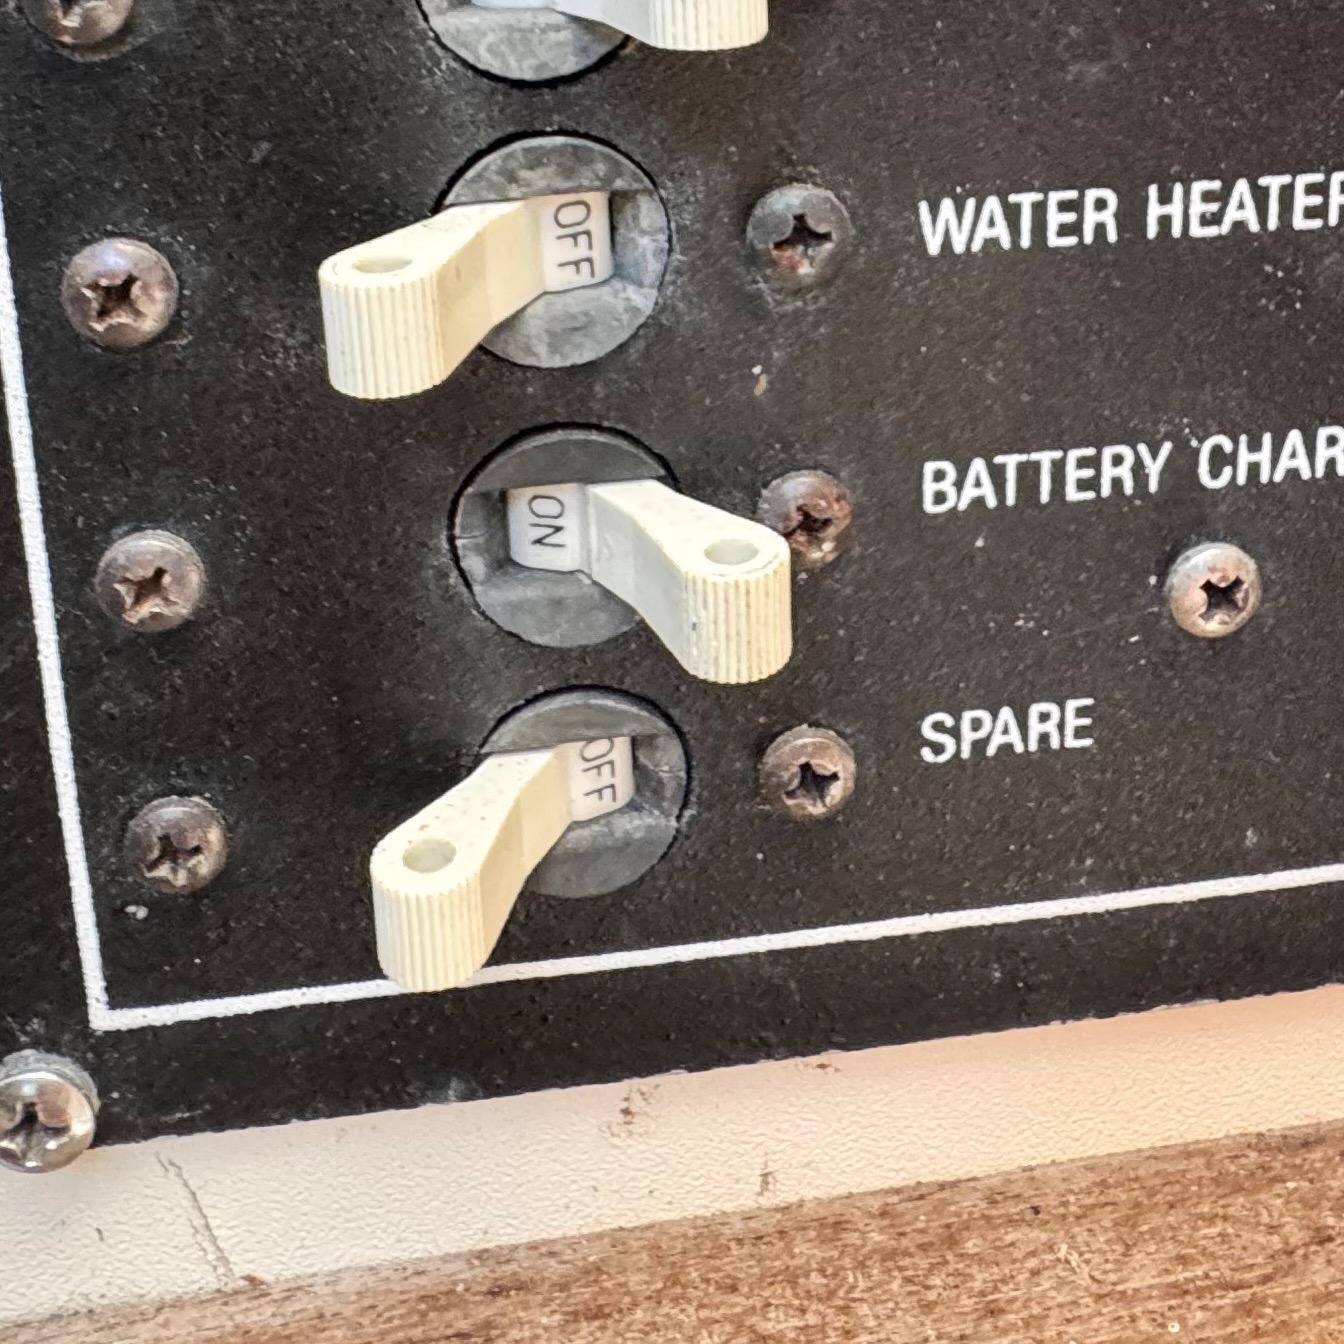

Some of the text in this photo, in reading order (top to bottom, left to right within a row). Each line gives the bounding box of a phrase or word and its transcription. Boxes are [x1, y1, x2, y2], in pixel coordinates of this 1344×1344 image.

[552, 199, 596, 279] OFF
[917, 187, 1119, 256] WATER
[922, 440, 1173, 515] BATTERY
[527, 494, 567, 549] ON
[920, 697, 1095, 764] SPARE
[579, 737, 617, 803] OFF
